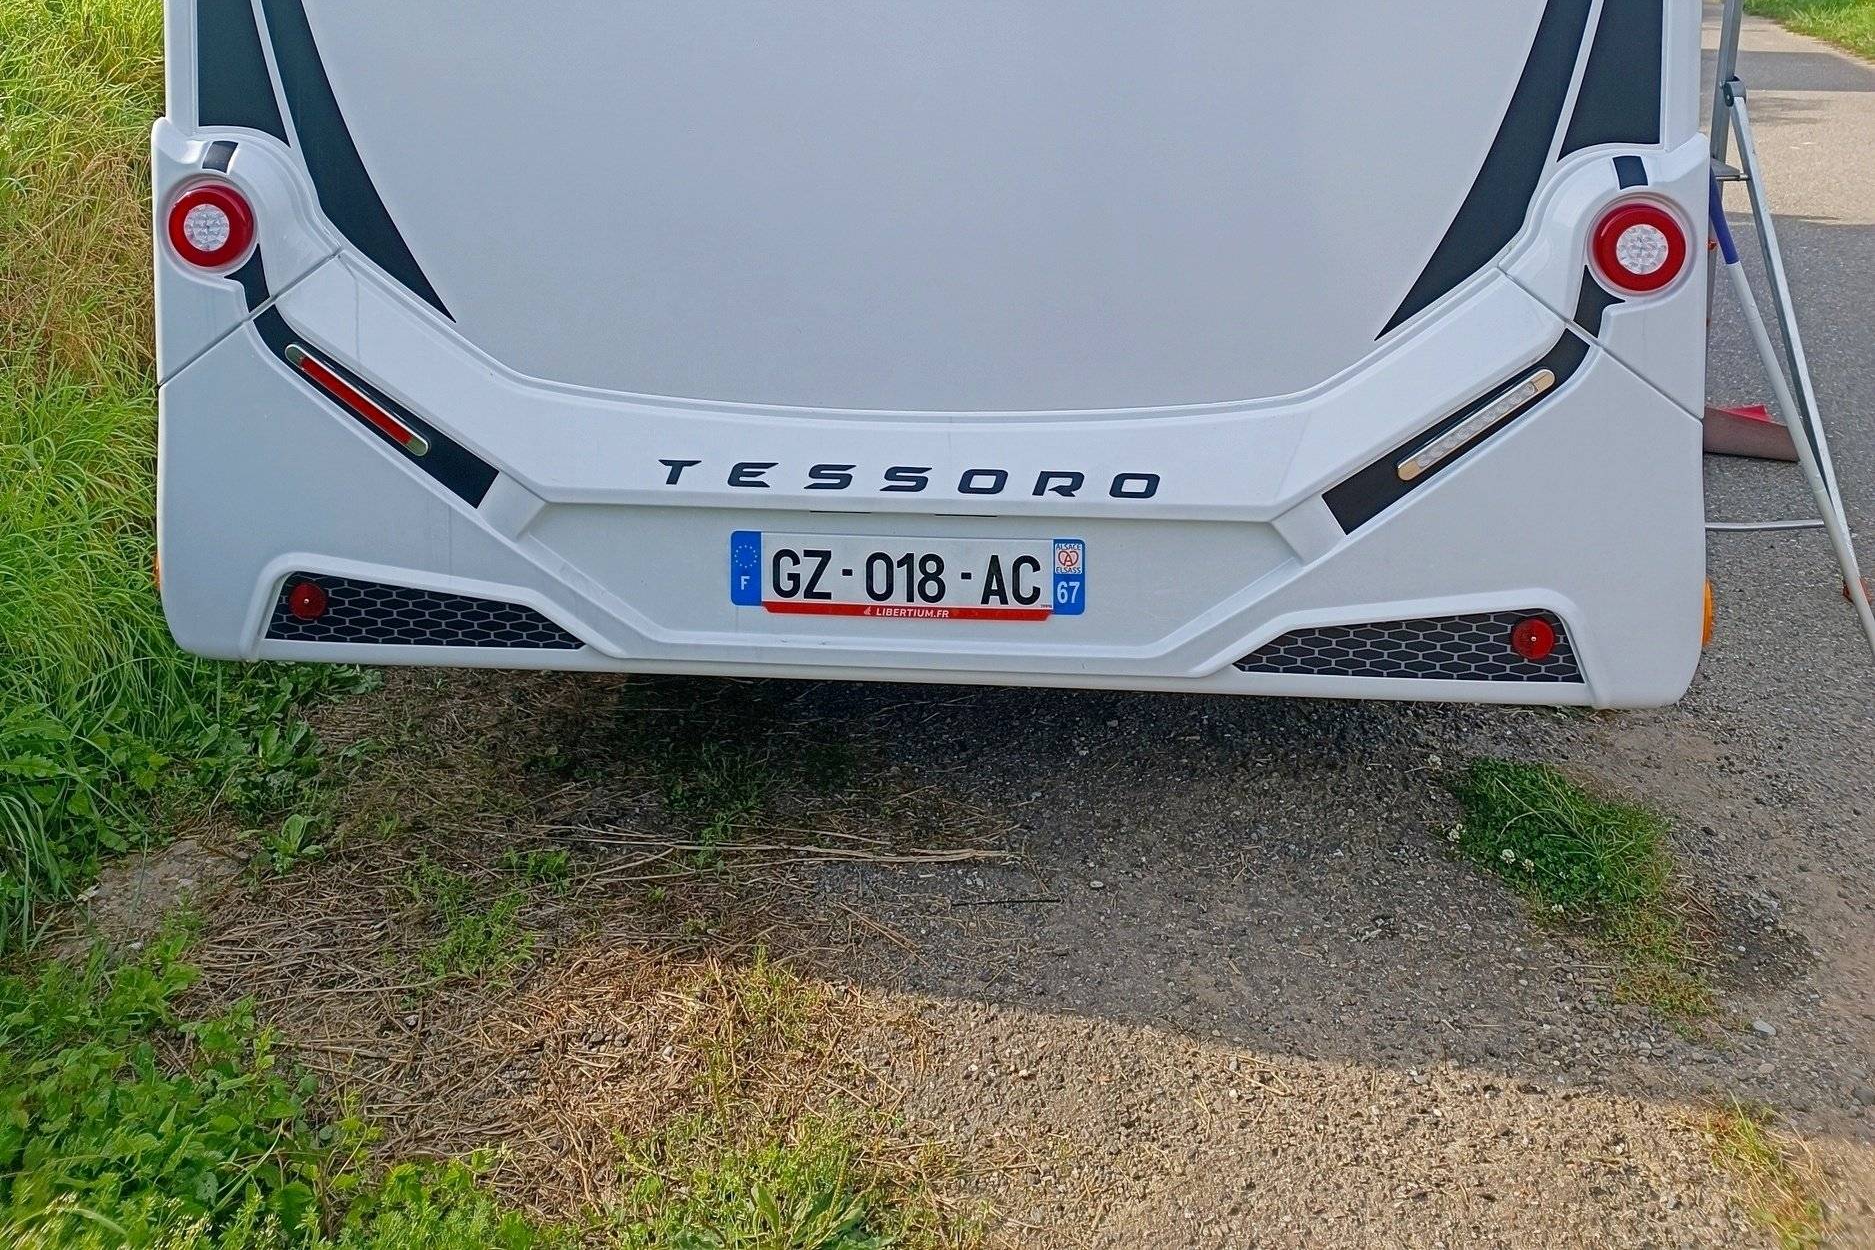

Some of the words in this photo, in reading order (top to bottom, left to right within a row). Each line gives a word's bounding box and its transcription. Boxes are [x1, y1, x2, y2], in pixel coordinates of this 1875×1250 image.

[657, 458, 1161, 500] TESSORO
[1056, 566, 1082, 574] ELSASS
[740, 575, 751, 591] F
[1056, 580, 1081, 604] 67
[875, 607, 950, 618] LIBERTIUM.FR
